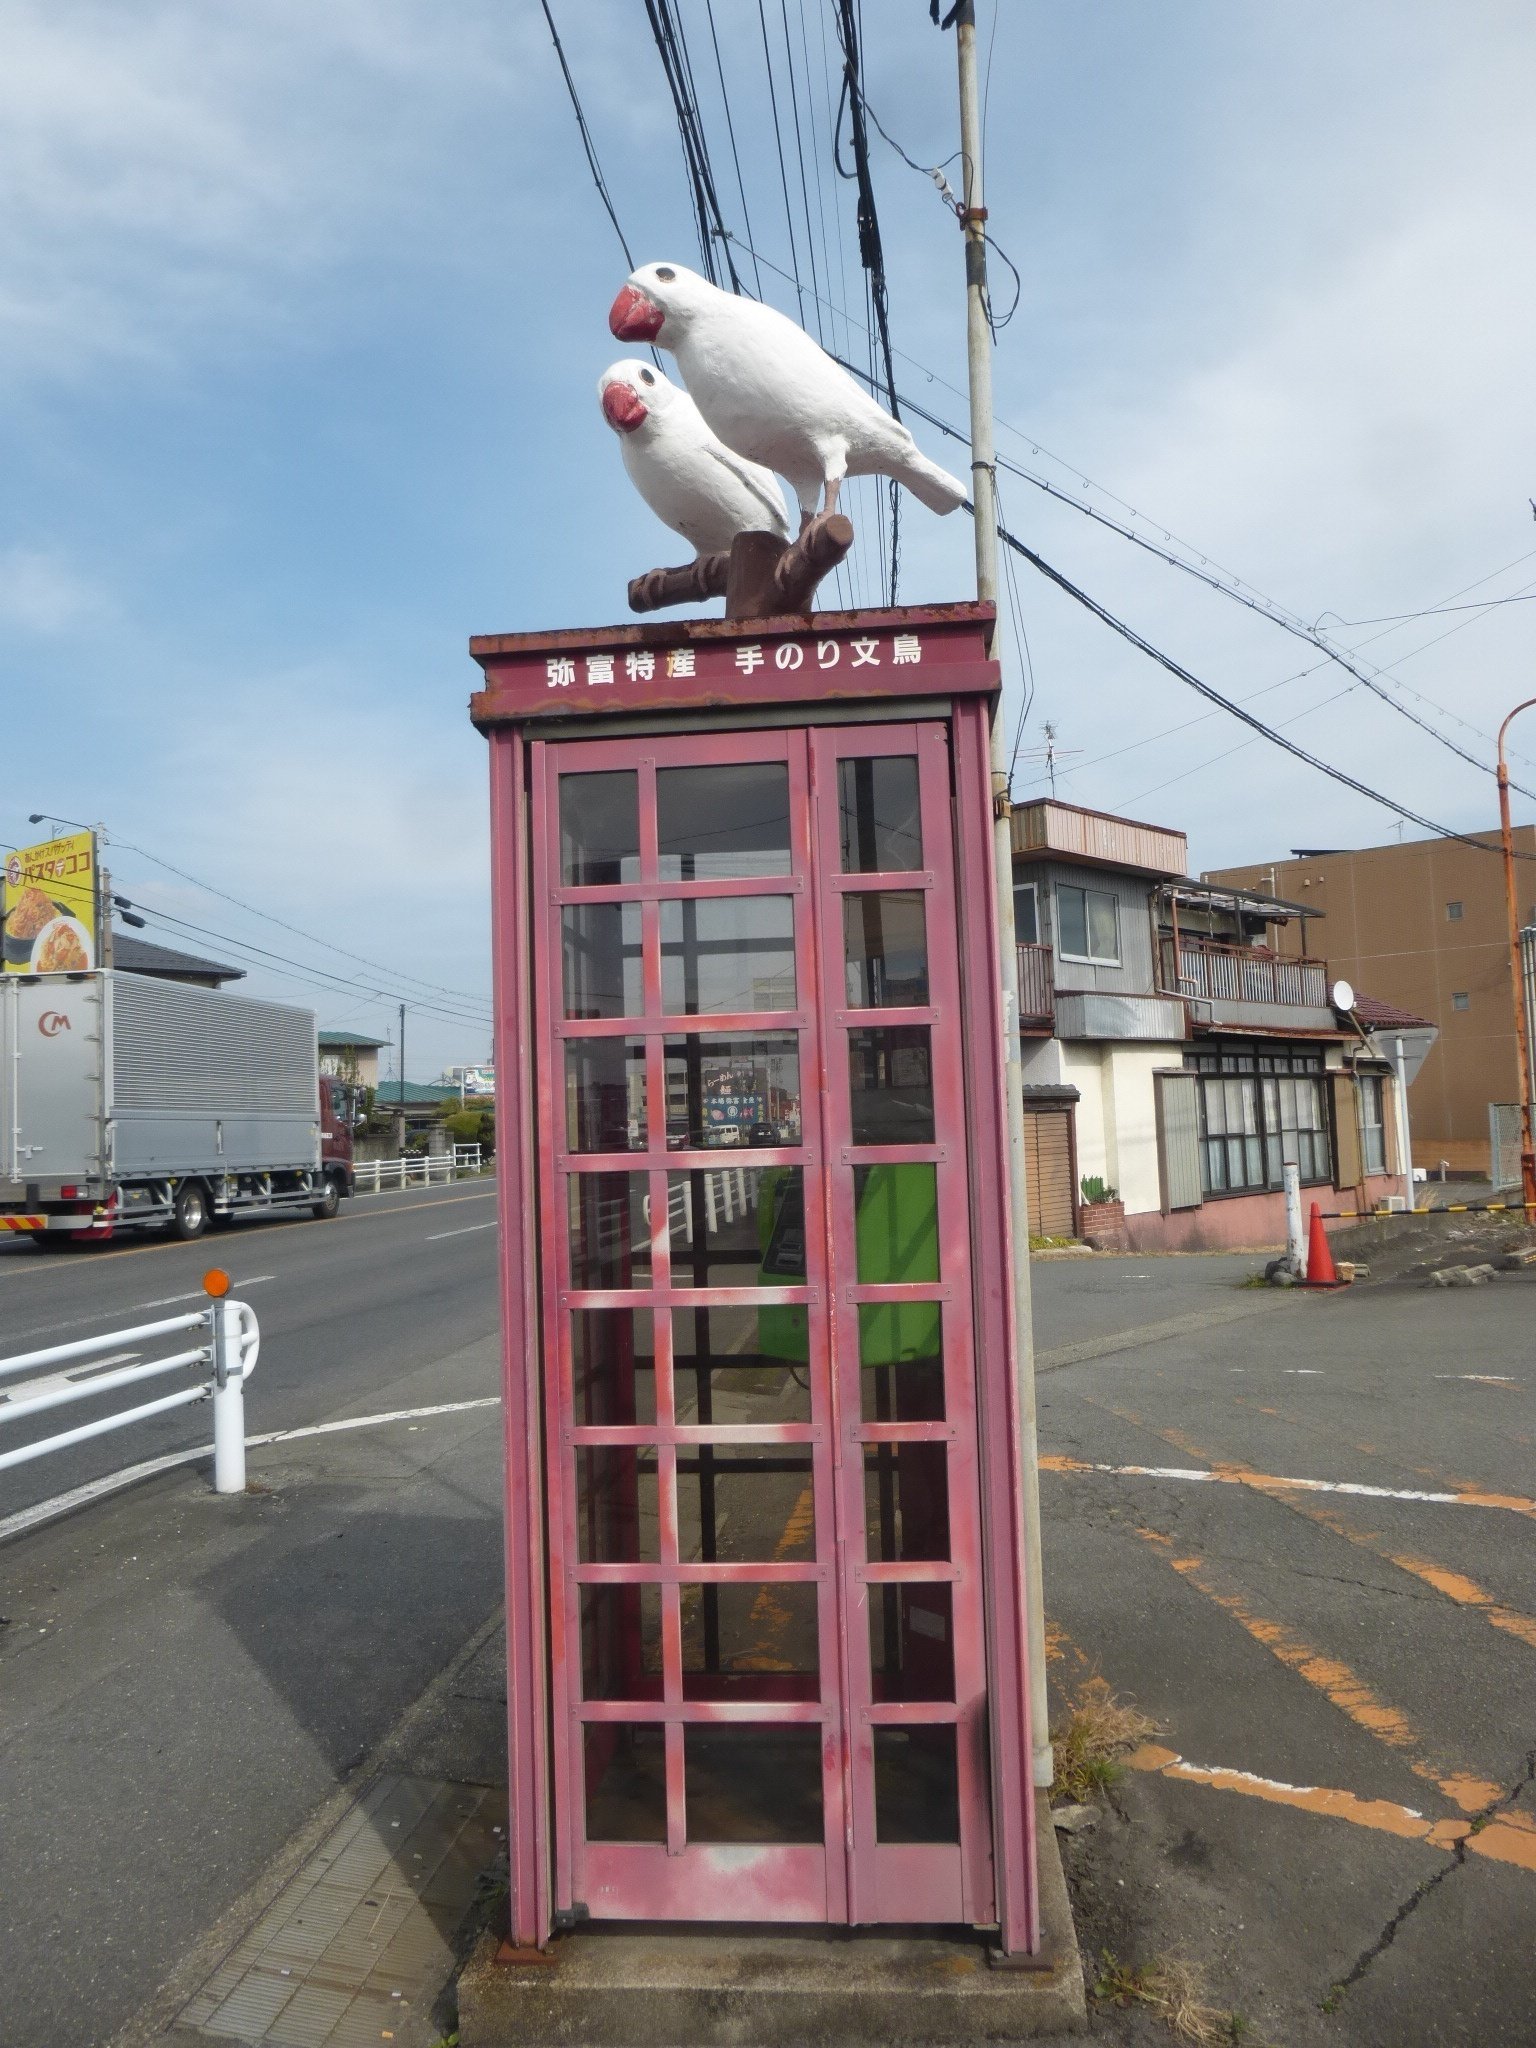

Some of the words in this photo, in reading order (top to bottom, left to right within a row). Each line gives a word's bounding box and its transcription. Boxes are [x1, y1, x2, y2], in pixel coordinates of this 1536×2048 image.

[546, 646, 697, 688] 弥富特産
[734, 633, 922, 676] 手のり文鳥
